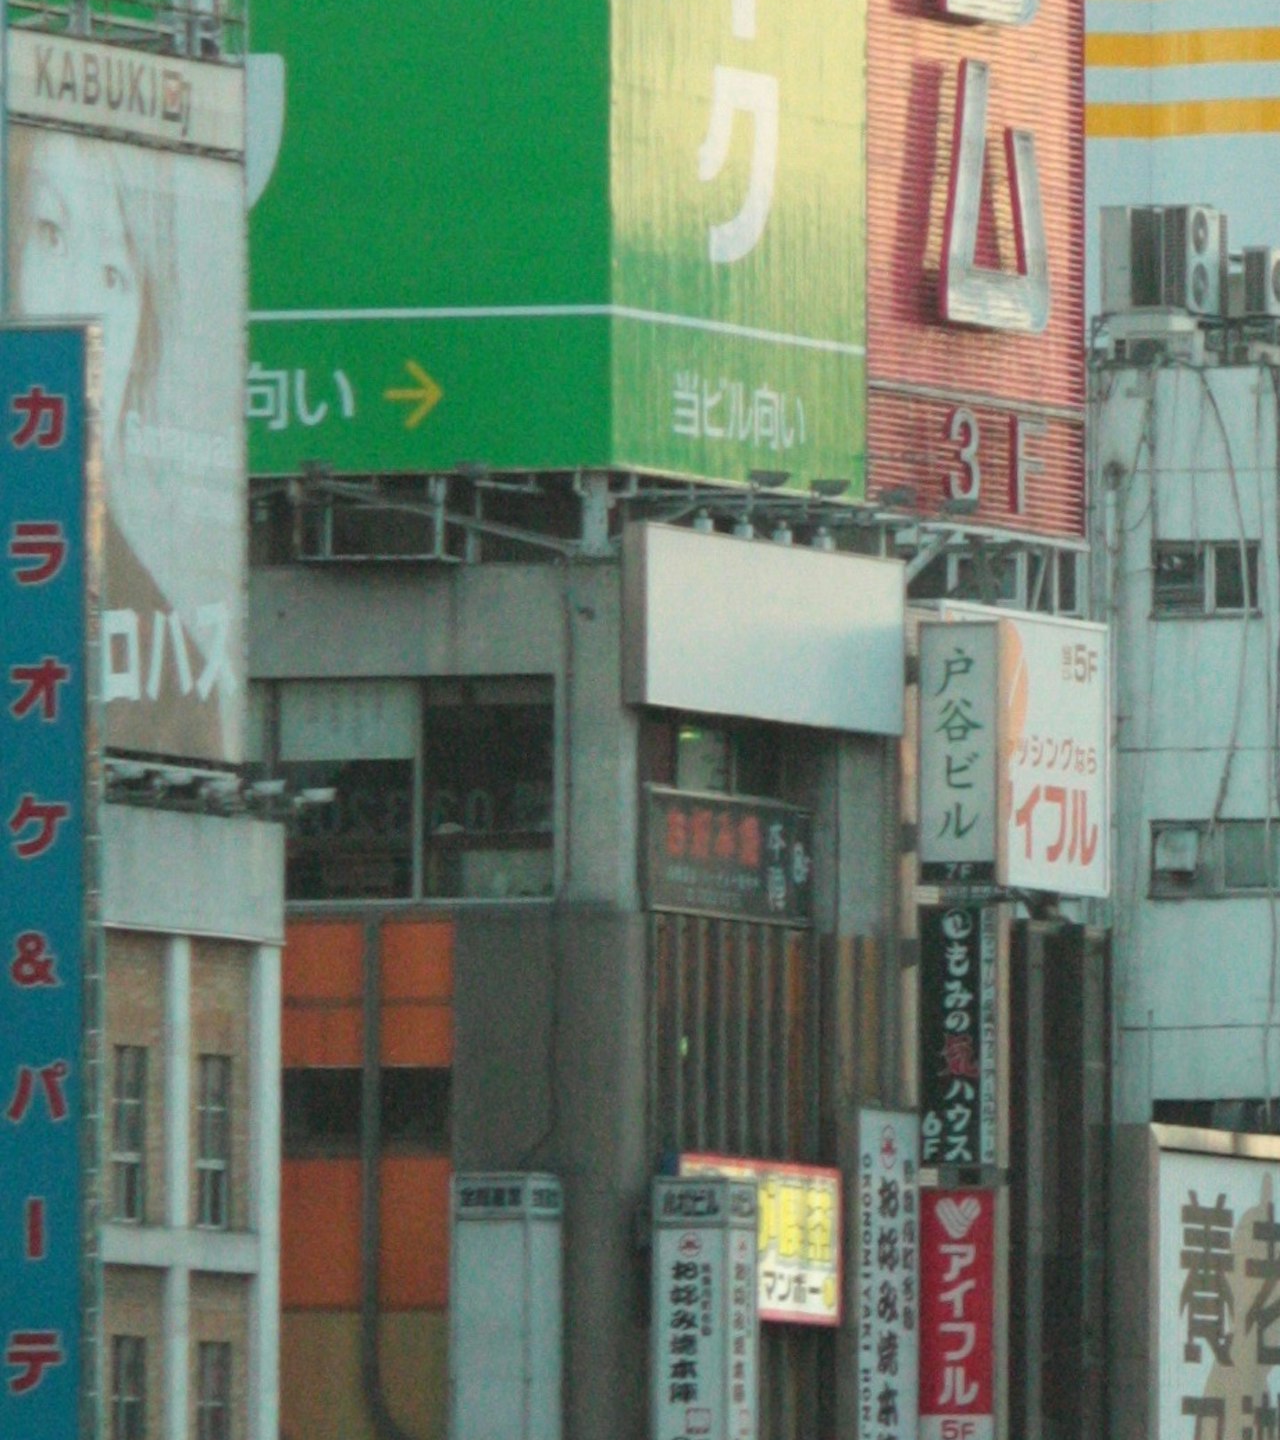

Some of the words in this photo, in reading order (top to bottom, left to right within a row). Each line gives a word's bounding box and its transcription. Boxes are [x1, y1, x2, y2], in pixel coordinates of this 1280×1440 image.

[940, 405, 980, 504] 3
[936, 646, 984, 841] 戸谷ビル
[936, 1245, 982, 1407] アイフル
[940, 1419, 976, 1440] 5F
